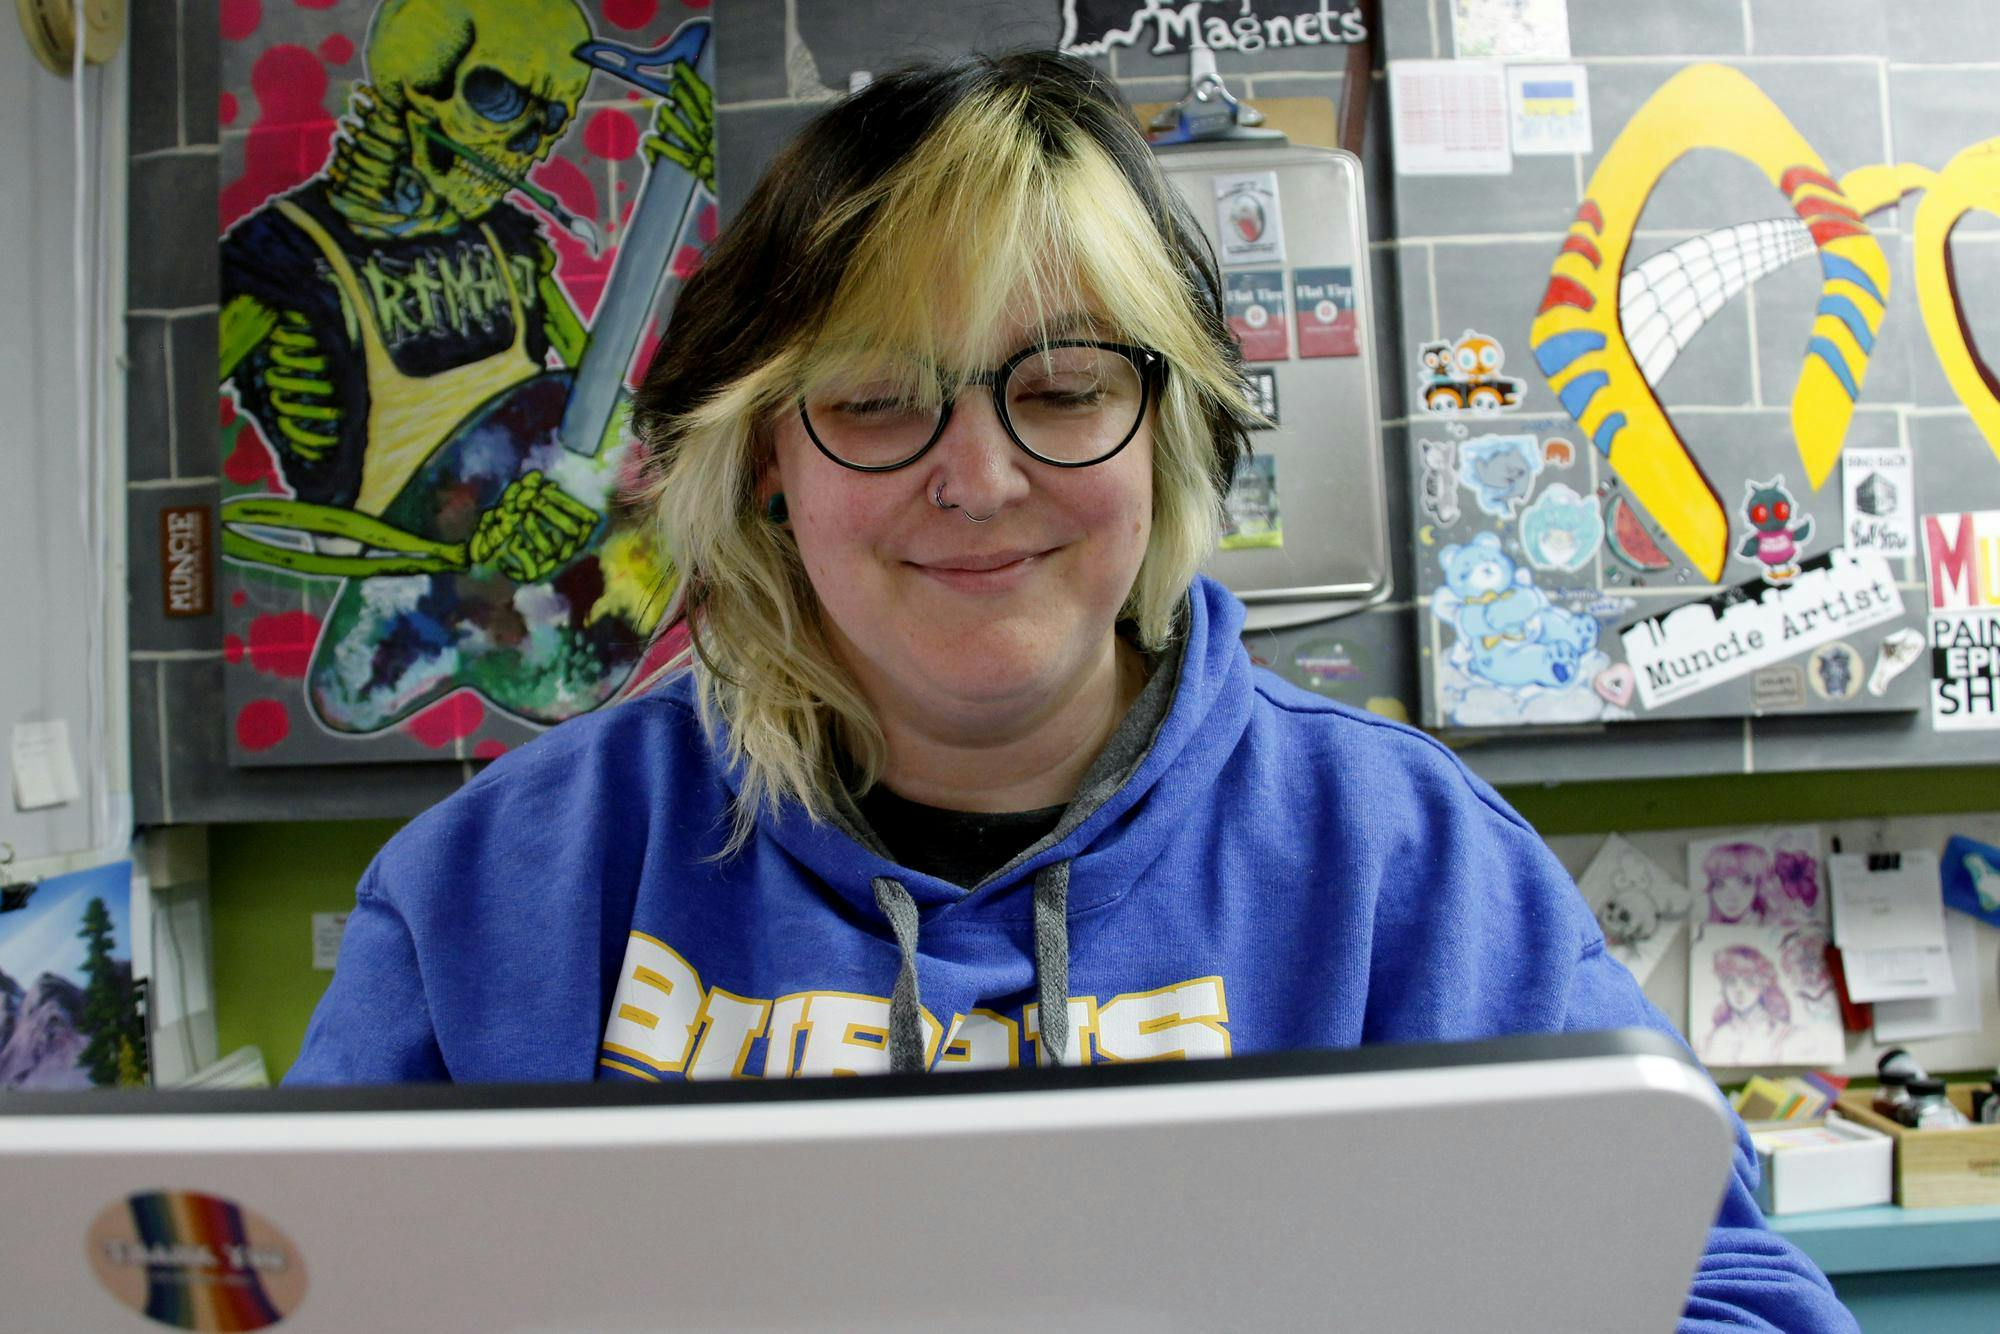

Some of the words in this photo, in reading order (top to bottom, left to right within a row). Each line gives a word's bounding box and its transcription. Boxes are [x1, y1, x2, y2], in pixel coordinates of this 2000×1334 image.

[1152, 3, 1368, 54] Magnets
[167, 511, 193, 611] MUNCIE
[1645, 629, 1764, 690] Muncie
[1782, 581, 1891, 640] Artist
